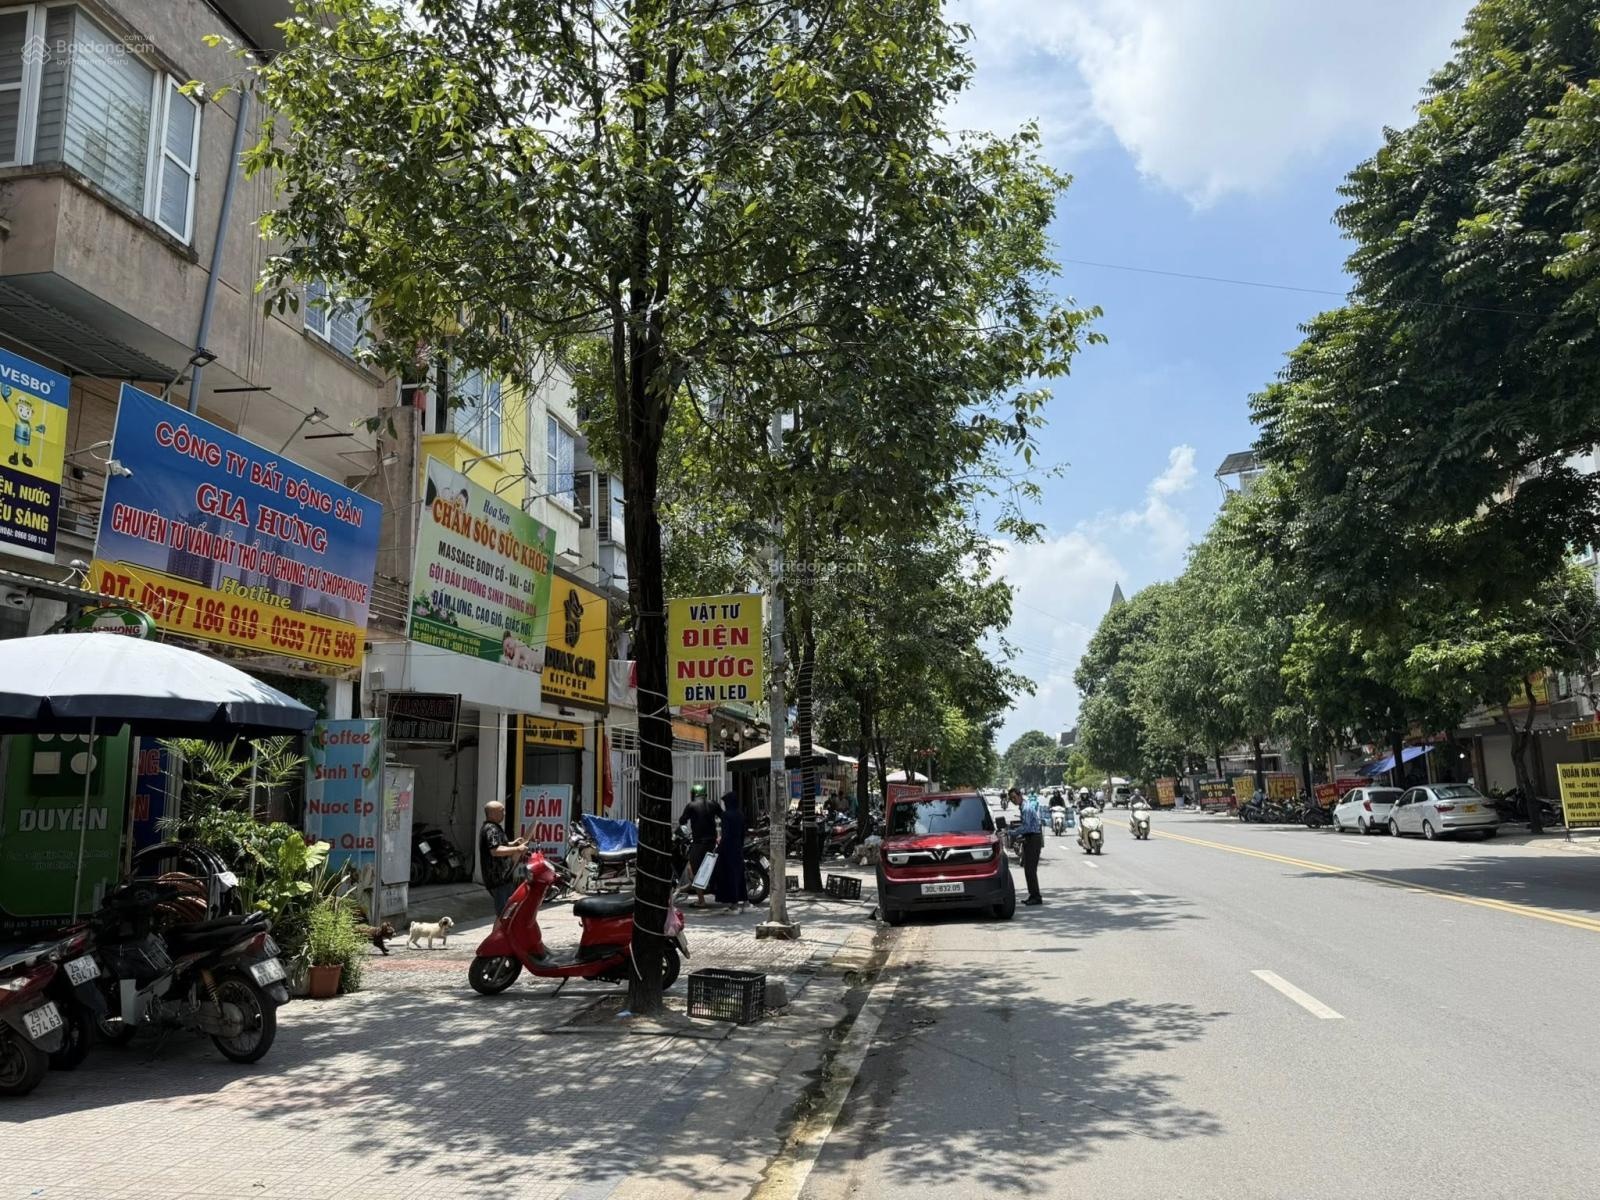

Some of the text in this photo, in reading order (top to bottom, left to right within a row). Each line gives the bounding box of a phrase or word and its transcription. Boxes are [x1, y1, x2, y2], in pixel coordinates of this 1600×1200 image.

[155, 421, 363, 528] CÔNG TY BẤT ĐỘNG SẢN
[19, 485, 51, 507] NƯỚC
[15, 507, 50, 533] SÁNG
[196, 483, 329, 554] GIA HƯNG
[483, 498, 511, 526] Hoa Sen
[432, 497, 473, 539] CHĂM
[472, 516, 498, 551] SÓC
[497, 528, 520, 562] SỨC
[111, 503, 168, 545] CHUYÊN
[169, 520, 188, 549] TƯ
[187, 521, 211, 558] VẤN
[213, 530, 237, 565] ĐẤT
[259, 551, 276, 576] CƯ
[275, 557, 306, 586] CHUNG
[306, 566, 323, 591] CƯ
[322, 572, 369, 604] SHOPHOUSE
[438, 540, 476, 572] MASSAGE
[475, 557, 495, 579] BODY
[508, 572, 519, 589] VAI
[219, 575, 292, 609] Hotline
[487, 586, 505, 606] SINH
[475, 605, 490, 625] CẠO
[690, 602, 741, 624] VẬT TƯ
[193, 597, 225, 634] 186
[306, 626, 333, 656] 775
[333, 631, 357, 659] 568
[682, 624, 750, 650] ĐIỆN
[677, 654, 754, 680] NƯỚC
[550, 671, 588, 691] KITCHEN
[685, 682, 747, 702] ĐÈN LED
[319, 729, 371, 746] Coffee
[315, 763, 372, 780] Sinh To
[308, 799, 350, 815] Nuoc
[353, 798, 375, 817] Ep
[524, 791, 563, 818] ĐẤM
[303, 833, 376, 850] Ha Qua
[30, 1014, 62, 1037] 574.63
